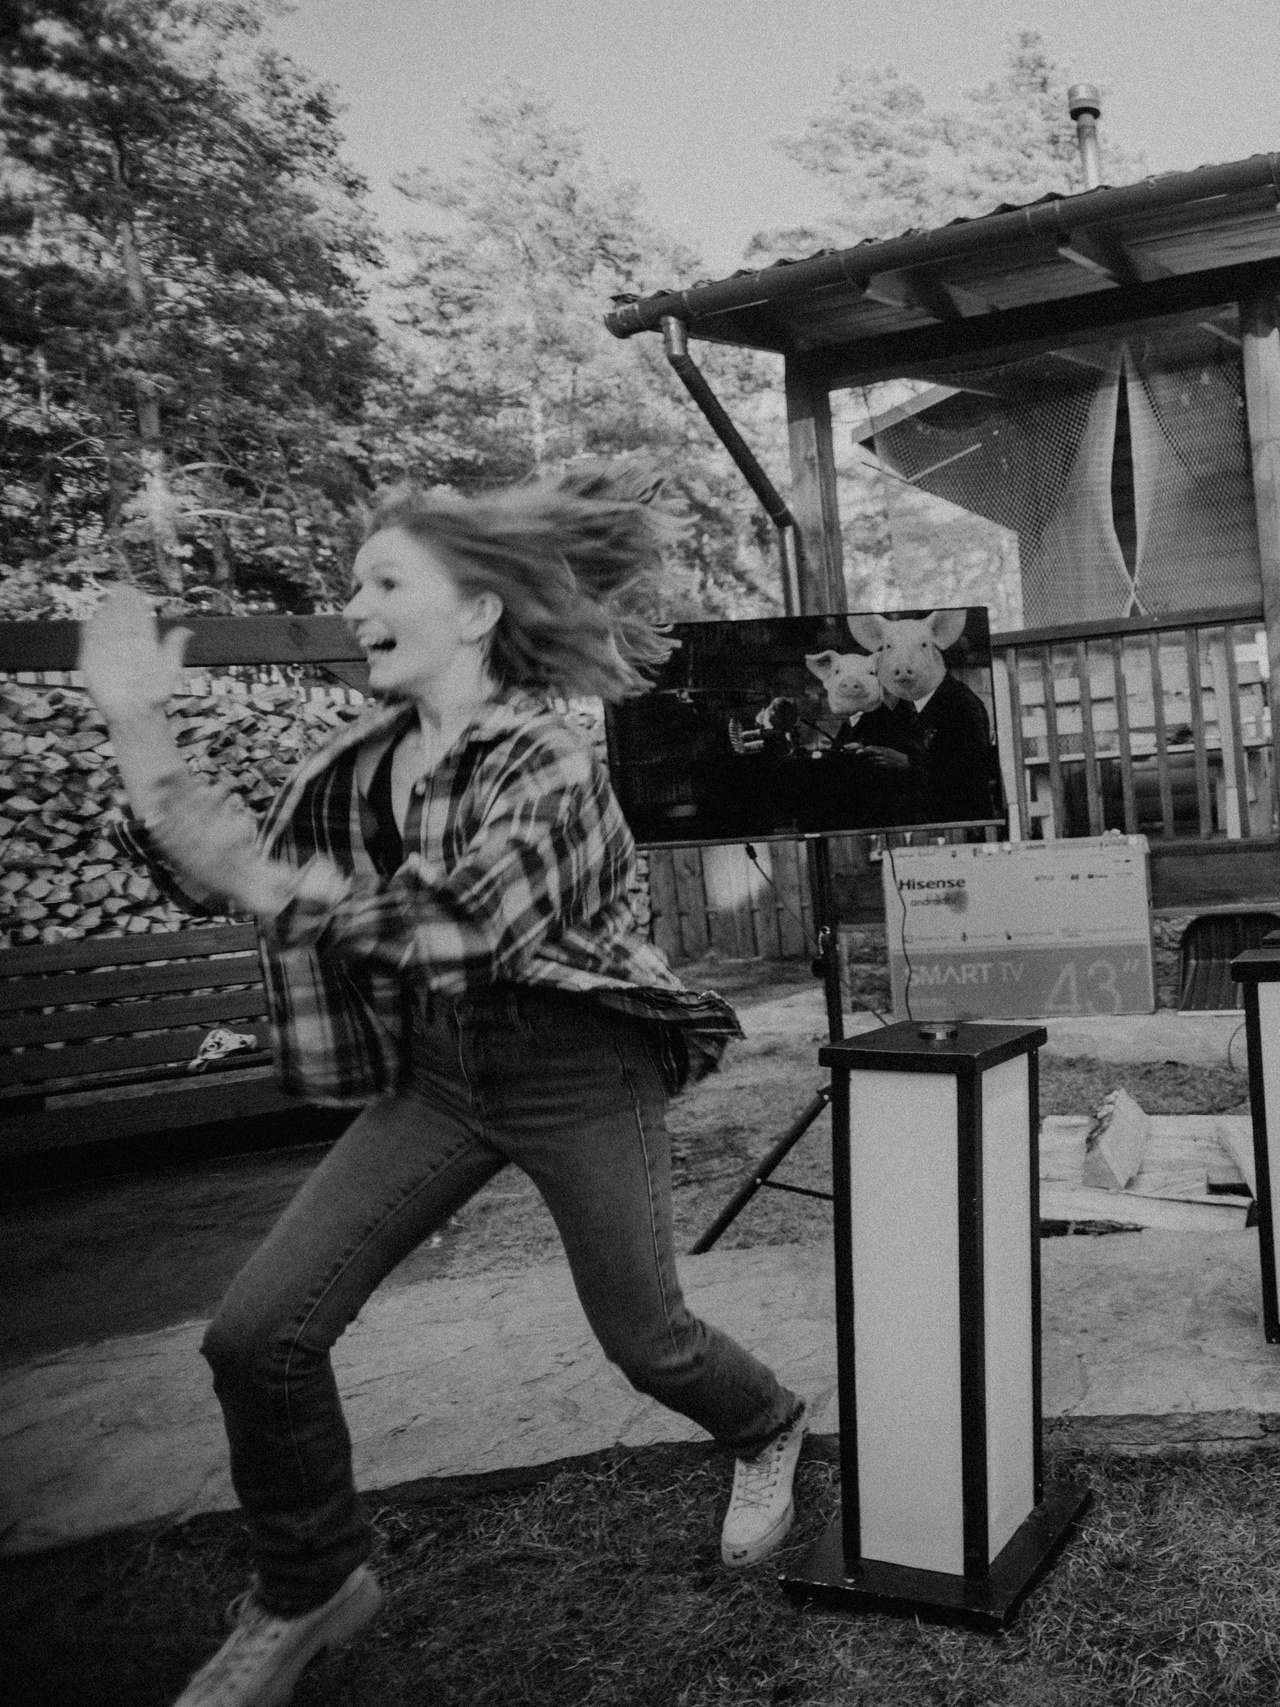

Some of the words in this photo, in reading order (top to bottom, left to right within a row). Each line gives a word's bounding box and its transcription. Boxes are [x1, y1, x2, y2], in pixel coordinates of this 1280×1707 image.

[899, 878, 966, 890] Hisense
[904, 963, 994, 987] SMART
[1001, 962, 1026, 983] TV
